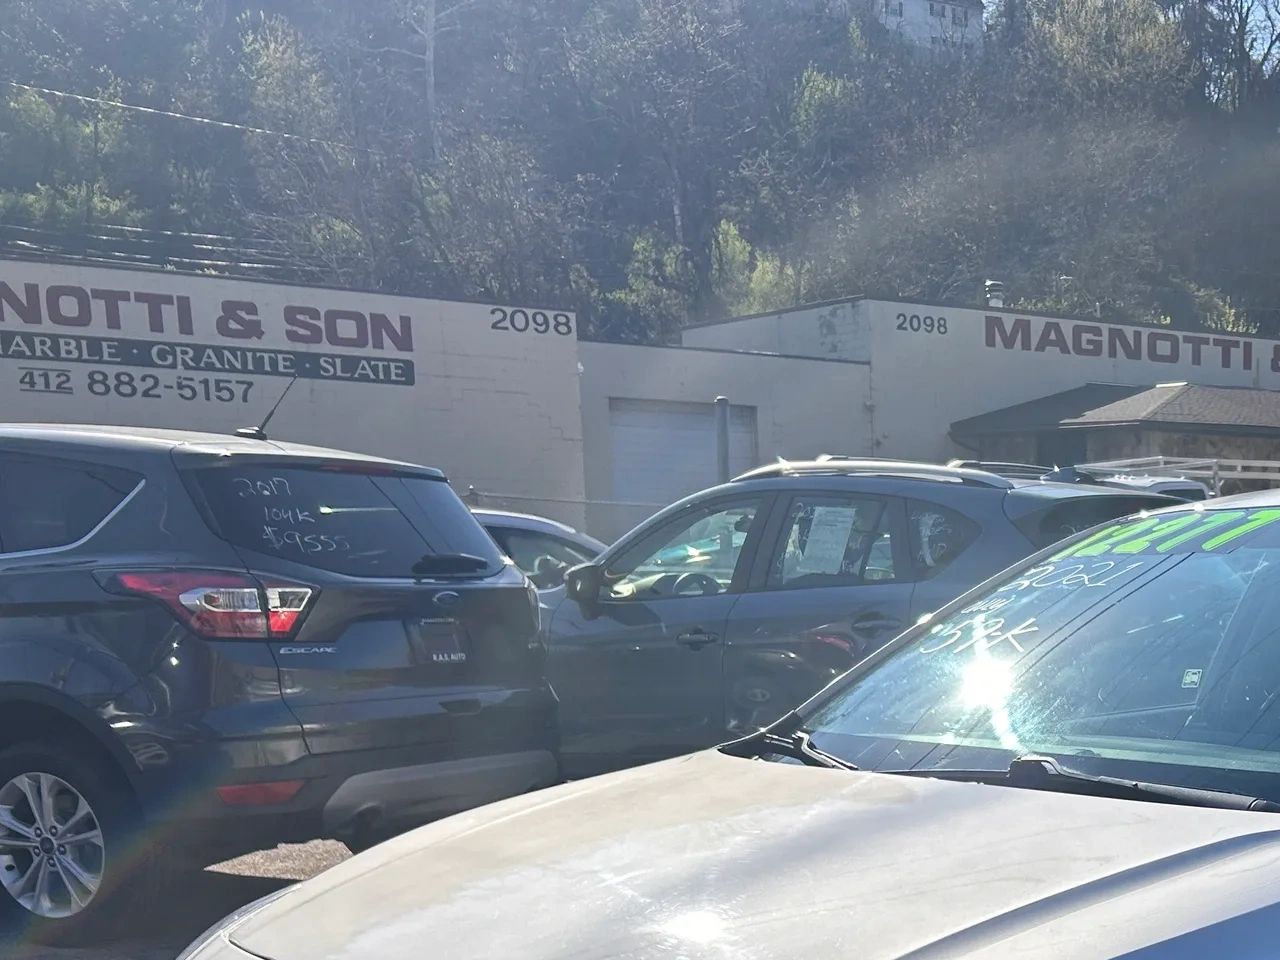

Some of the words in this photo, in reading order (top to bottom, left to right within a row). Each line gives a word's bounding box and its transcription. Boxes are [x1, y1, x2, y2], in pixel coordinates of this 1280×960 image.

[0, 281, 194, 335] NOTTI
[216, 300, 265, 340] &
[284, 305, 414, 352] SON
[490, 307, 573, 335] 2098
[896, 313, 948, 335] 2098
[0, 336, 121, 361] ARBLE
[151, 345, 296, 374] GRANITE
[319, 359, 406, 381] SLATE
[984, 316, 1253, 371] MAGNOTTI
[19, 371, 71, 391] 412
[87, 370, 254, 403] 882-5157
[232, 477, 292, 497] 2017
[997, 561, 1144, 591] 2021
[279, 646, 338, 655] ESCAPE
